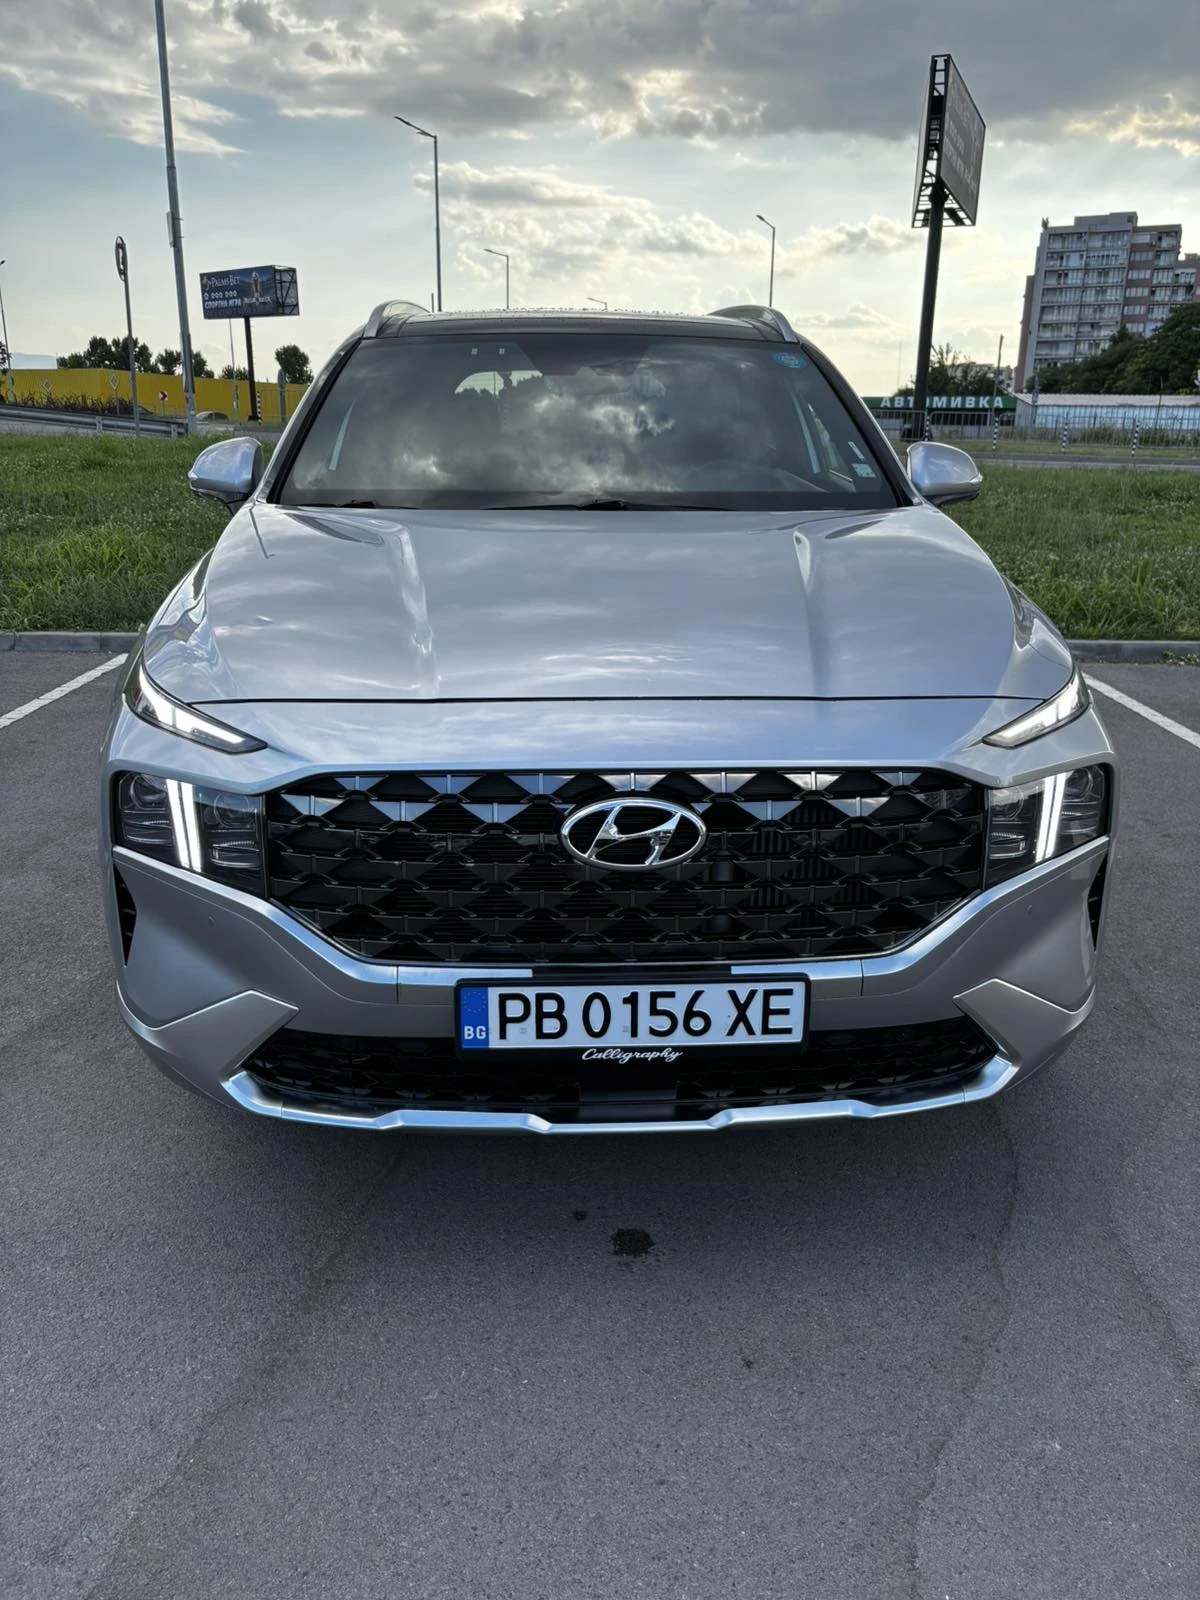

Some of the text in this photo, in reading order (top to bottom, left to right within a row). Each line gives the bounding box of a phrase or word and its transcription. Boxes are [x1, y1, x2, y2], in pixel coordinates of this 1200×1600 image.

[880, 396, 1004, 408] АВТМИВКА
[498, 988, 794, 1040] PB 0156 XE
[464, 1025, 487, 1040] BG
[582, 1047, 684, 1064] Calligraphy
